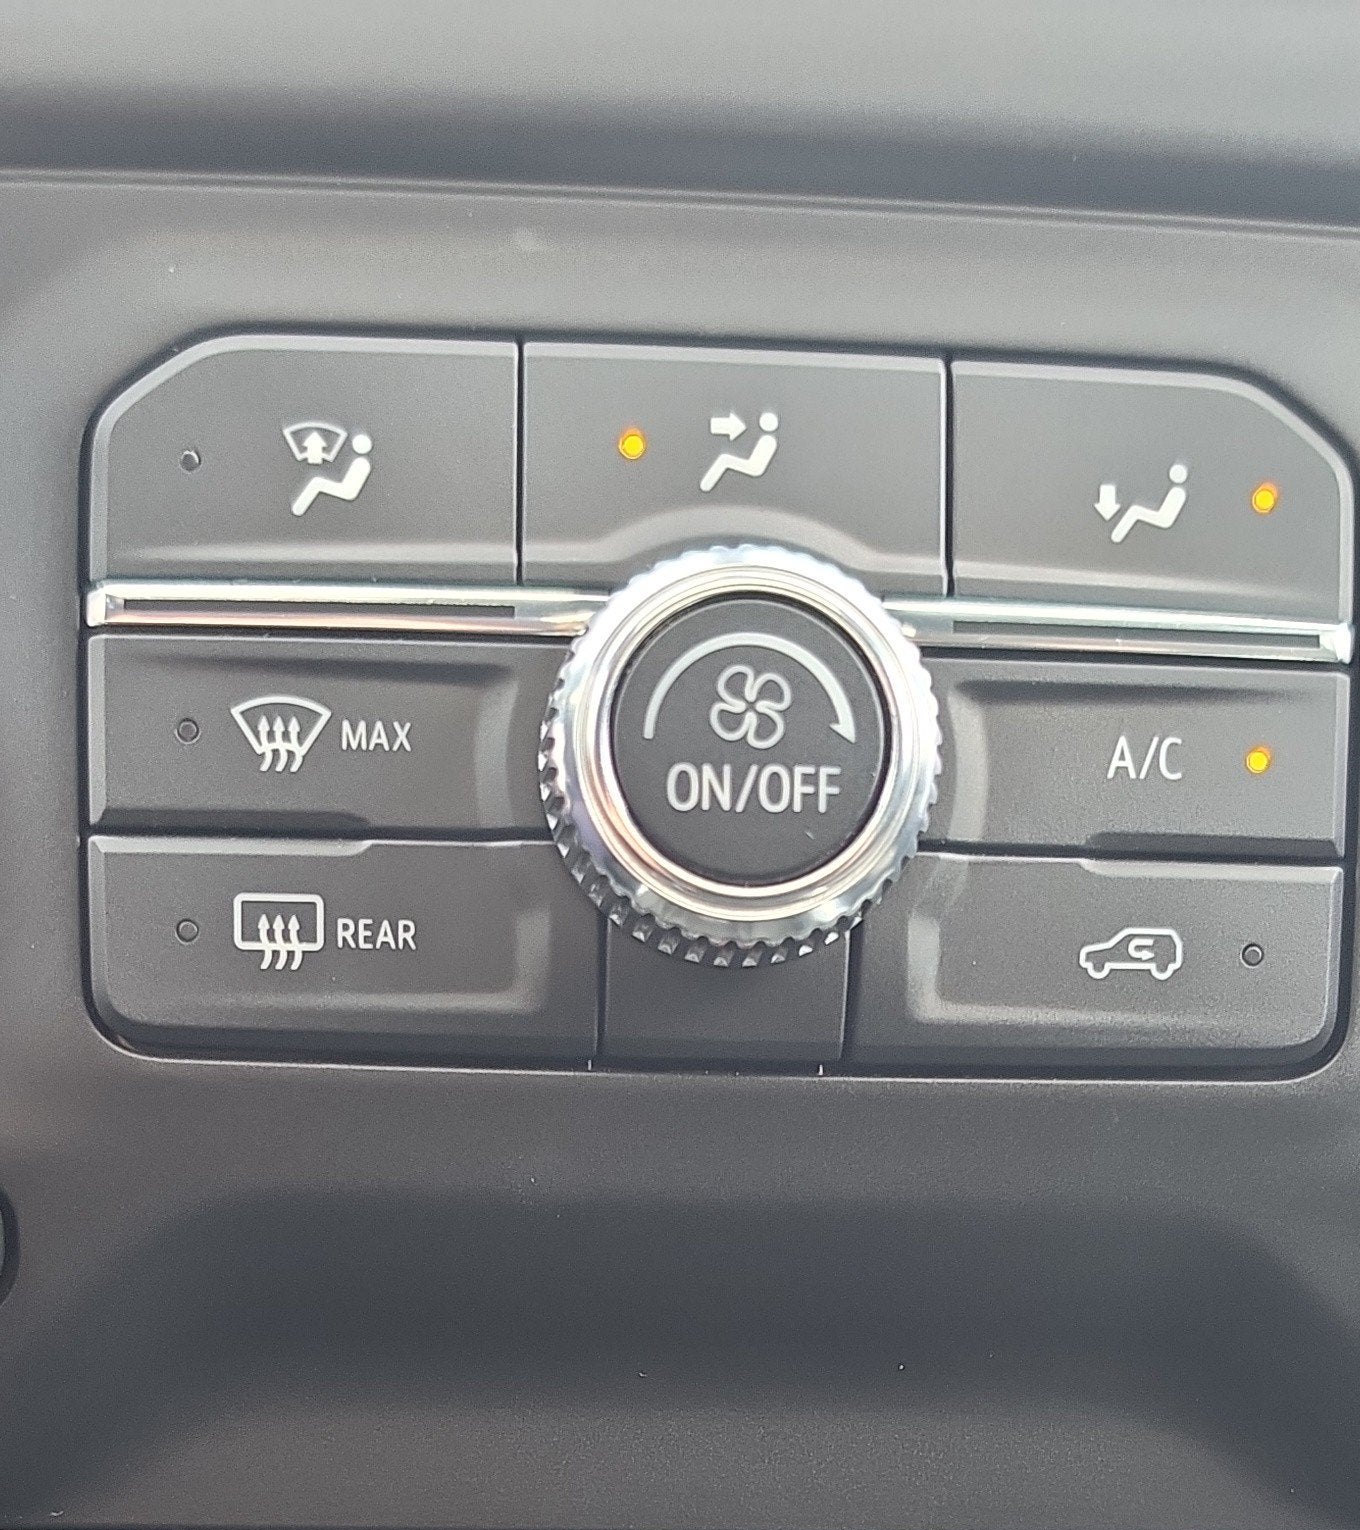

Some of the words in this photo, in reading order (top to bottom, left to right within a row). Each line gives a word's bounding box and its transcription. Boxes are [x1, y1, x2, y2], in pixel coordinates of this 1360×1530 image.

[341, 718, 412, 752] MAX
[1106, 735, 1183, 781] A/C
[666, 762, 842, 814] ON/OFF
[337, 917, 417, 951] REAR
